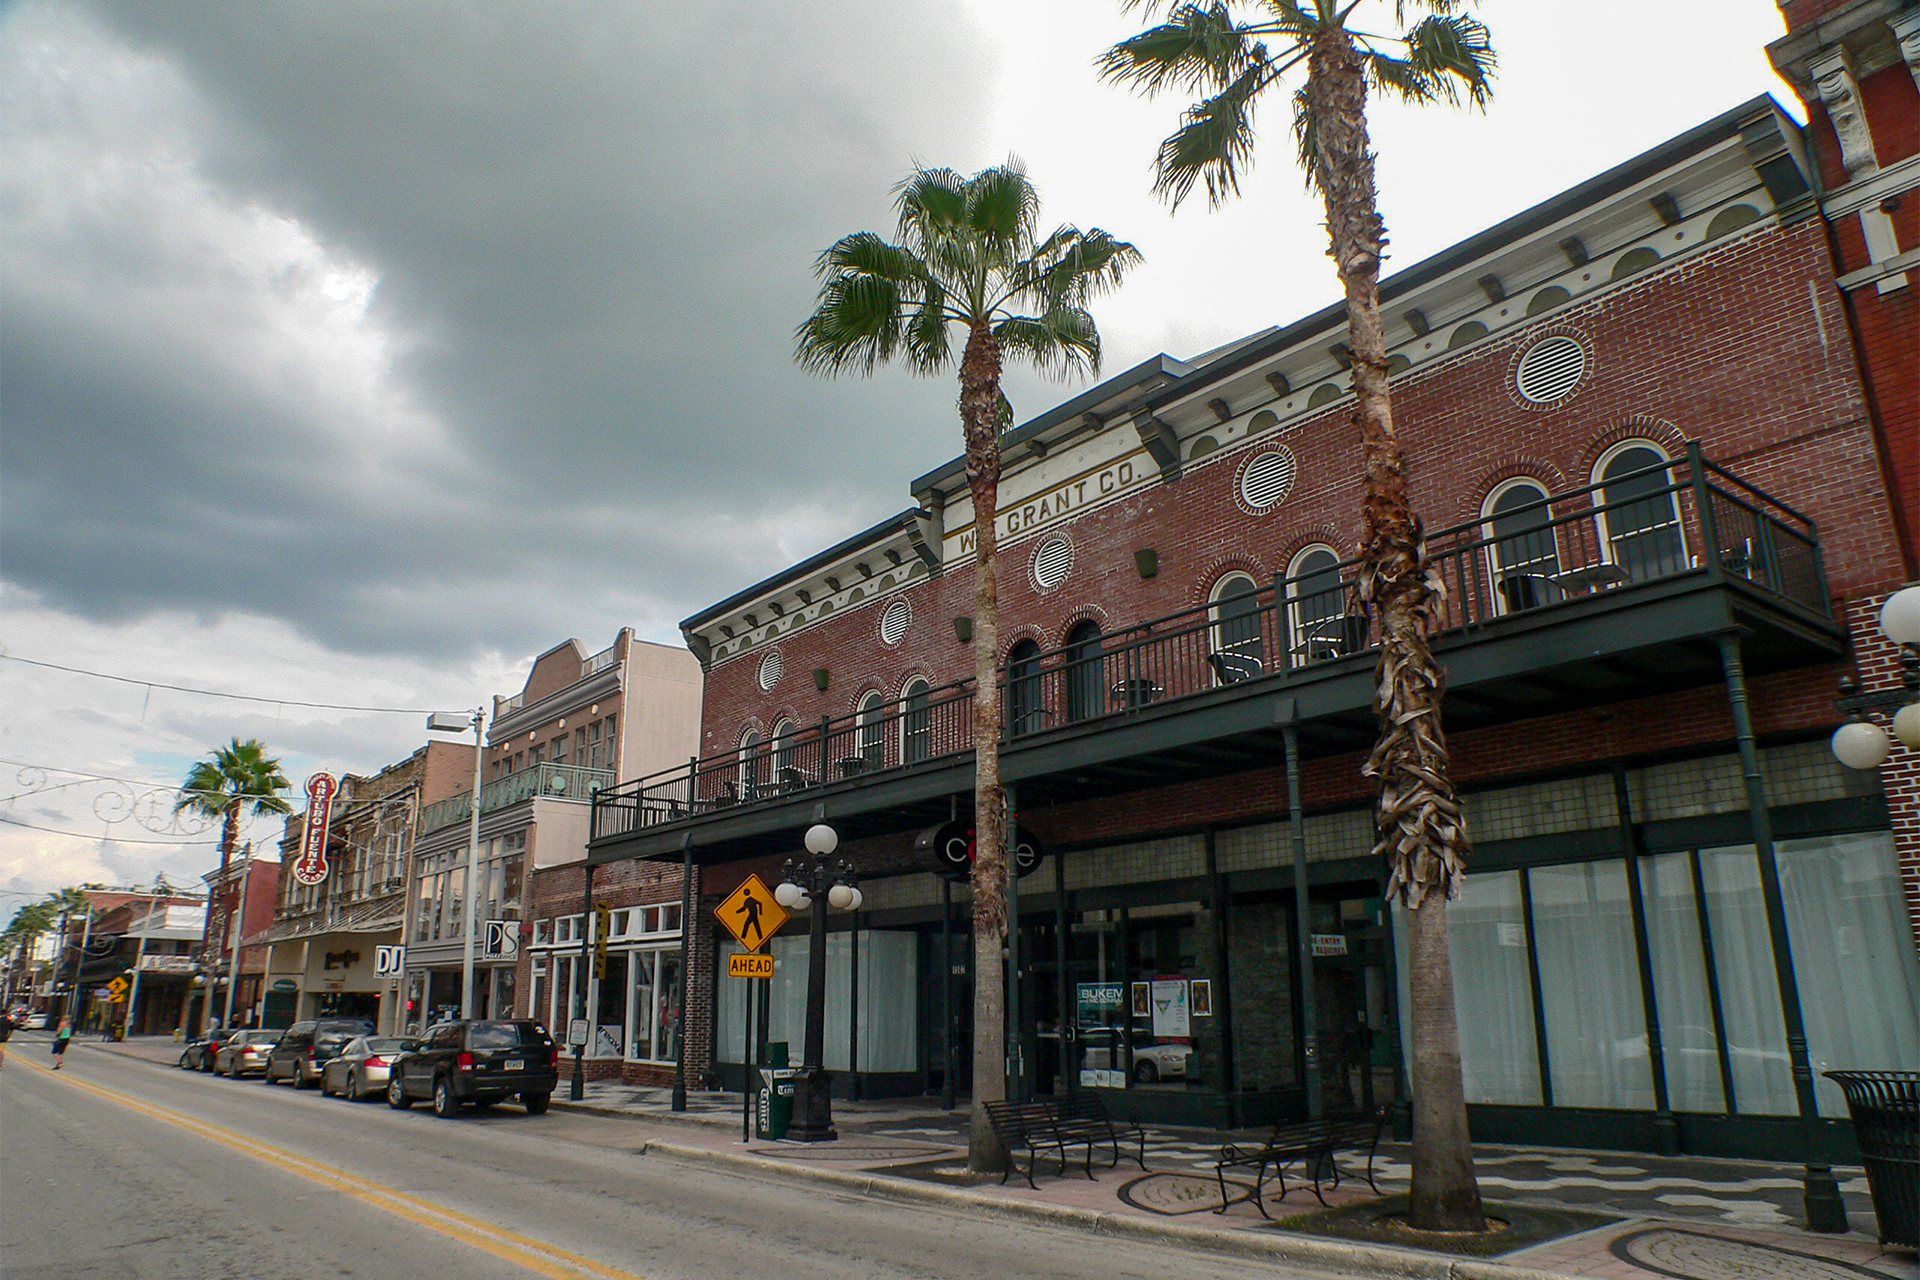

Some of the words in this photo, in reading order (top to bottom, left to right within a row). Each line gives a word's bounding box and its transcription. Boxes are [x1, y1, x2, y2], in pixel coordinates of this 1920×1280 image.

[1006, 481, 1087, 533] GRANT
[1099, 461, 1142, 494] CO.
[312, 781, 327, 826] ARTURO
[306, 827, 322, 873] FUENTE
[297, 867, 325, 882] CIGARS
[377, 948, 402, 973] DJ
[731, 958, 772, 972] AHEAD
[760, 1088, 770, 1133] Times
